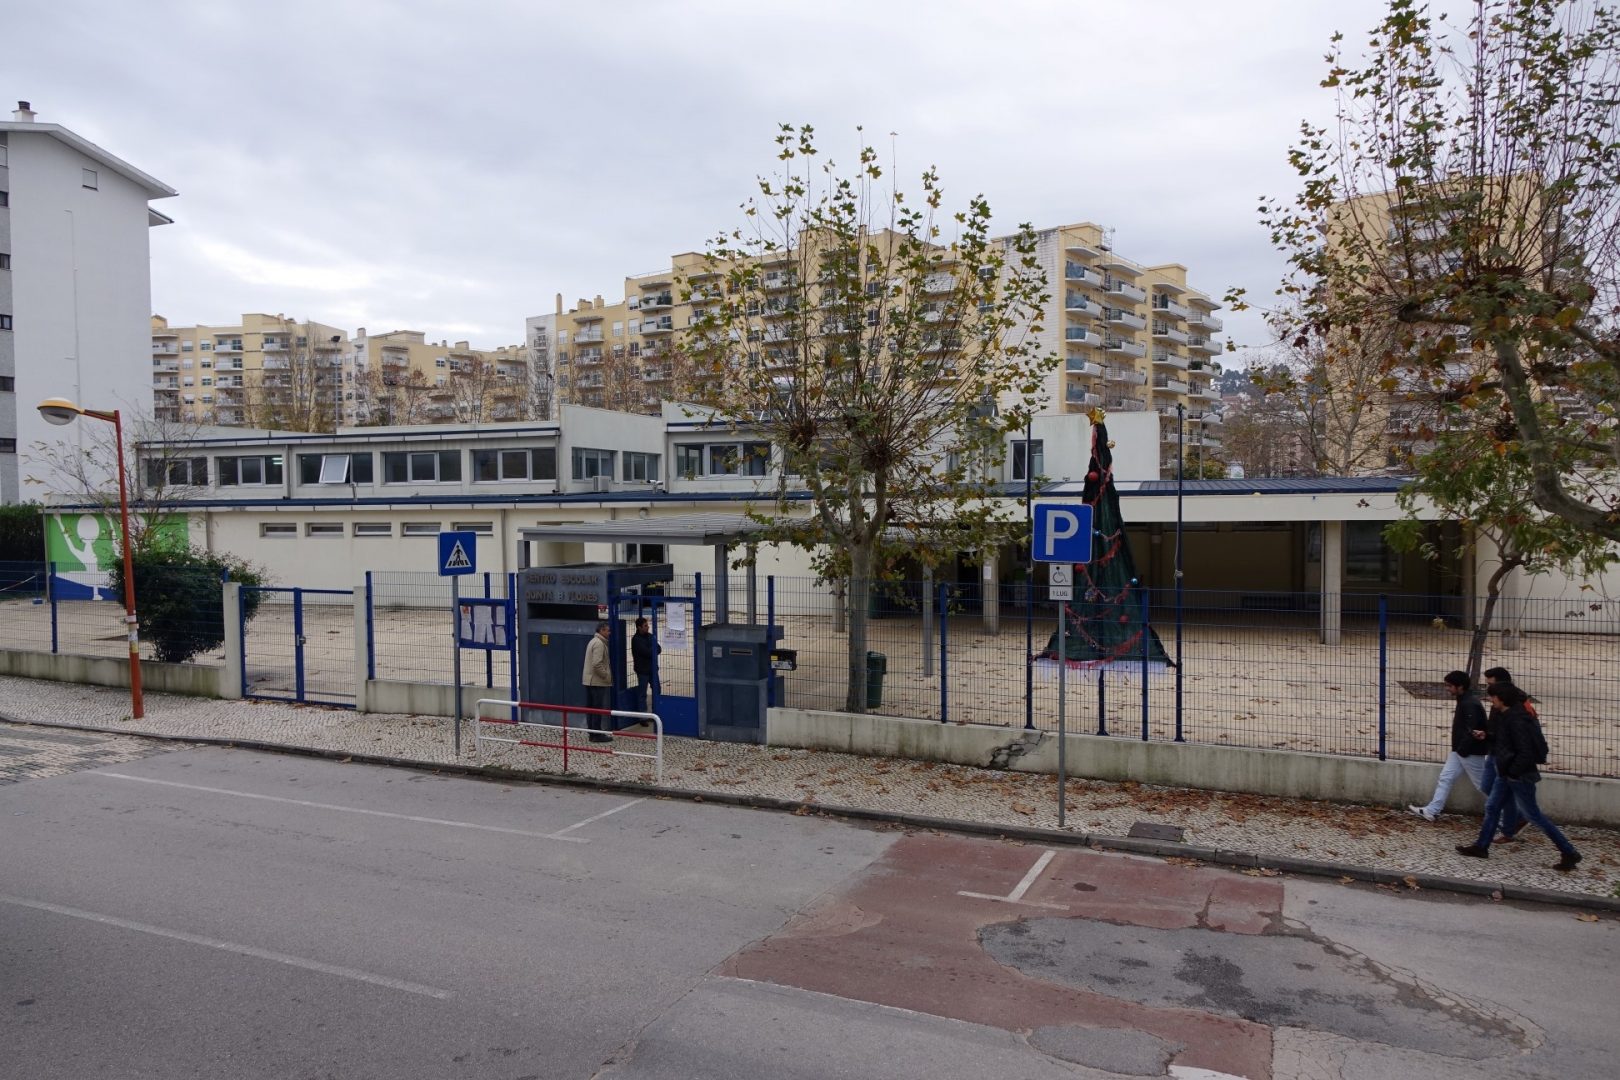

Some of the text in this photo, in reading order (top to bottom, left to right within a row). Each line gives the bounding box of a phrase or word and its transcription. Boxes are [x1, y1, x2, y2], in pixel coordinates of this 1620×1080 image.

[1045, 509, 1079, 555] P
[527, 574, 599, 585] CENTRO ESCOLAR
